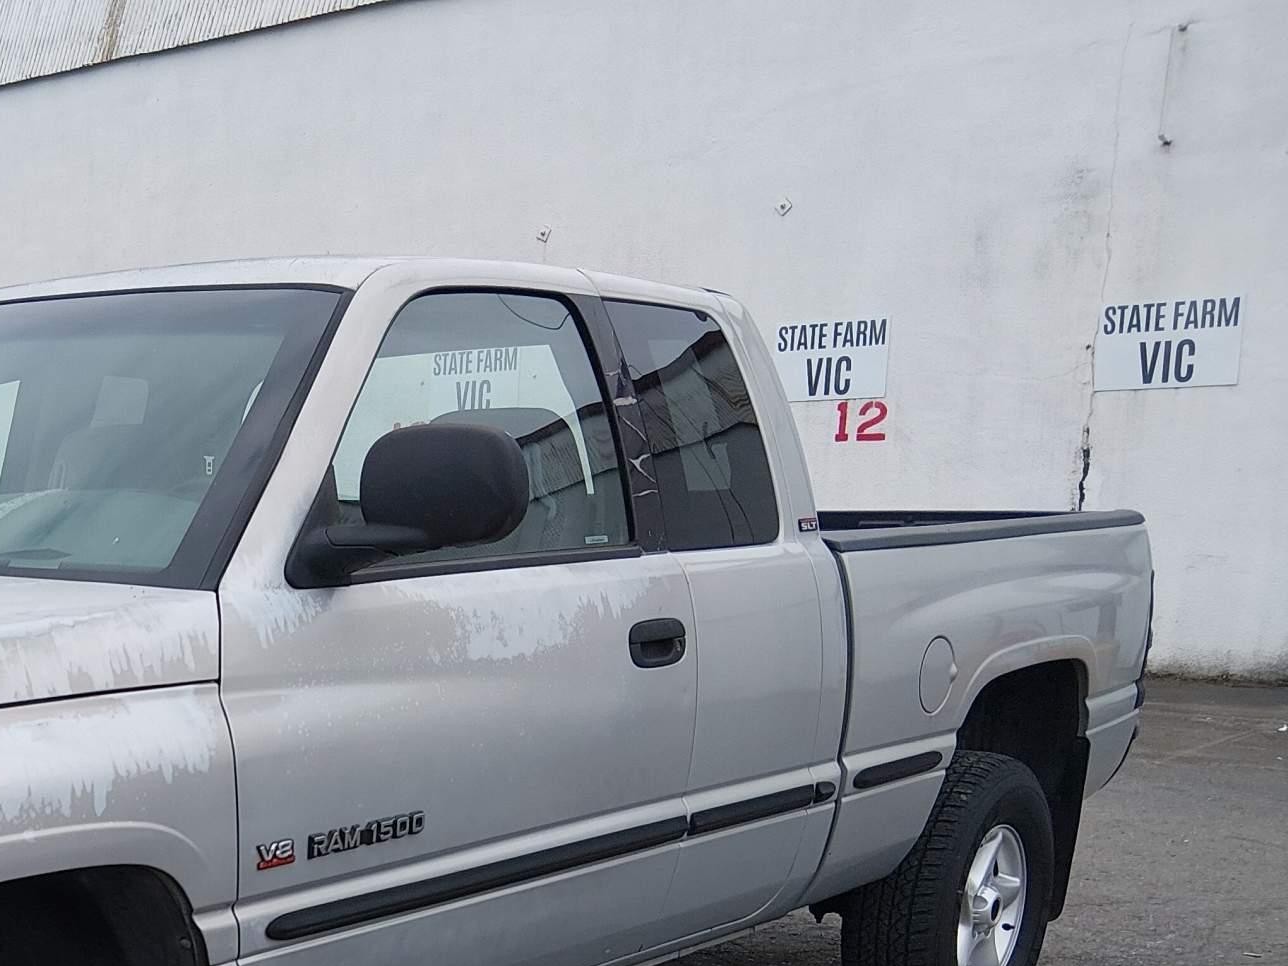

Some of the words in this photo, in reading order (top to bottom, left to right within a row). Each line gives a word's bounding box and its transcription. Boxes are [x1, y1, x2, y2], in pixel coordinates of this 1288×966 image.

[777, 322, 828, 352] STATE
[832, 318, 887, 349] FARM
[1103, 302, 1167, 335] STATE
[1172, 296, 1241, 331] FARM
[433, 350, 473, 376] STATE
[476, 347, 518, 373] FARM
[806, 355, 852, 397] VIC
[1139, 338, 1196, 385] VIC
[455, 379, 492, 410] VIC
[834, 400, 888, 442] 12
[801, 521, 817, 531] SLT
[257, 838, 295, 863] V8
[309, 823, 363, 859] RAM
[365, 810, 426, 846] 1500
